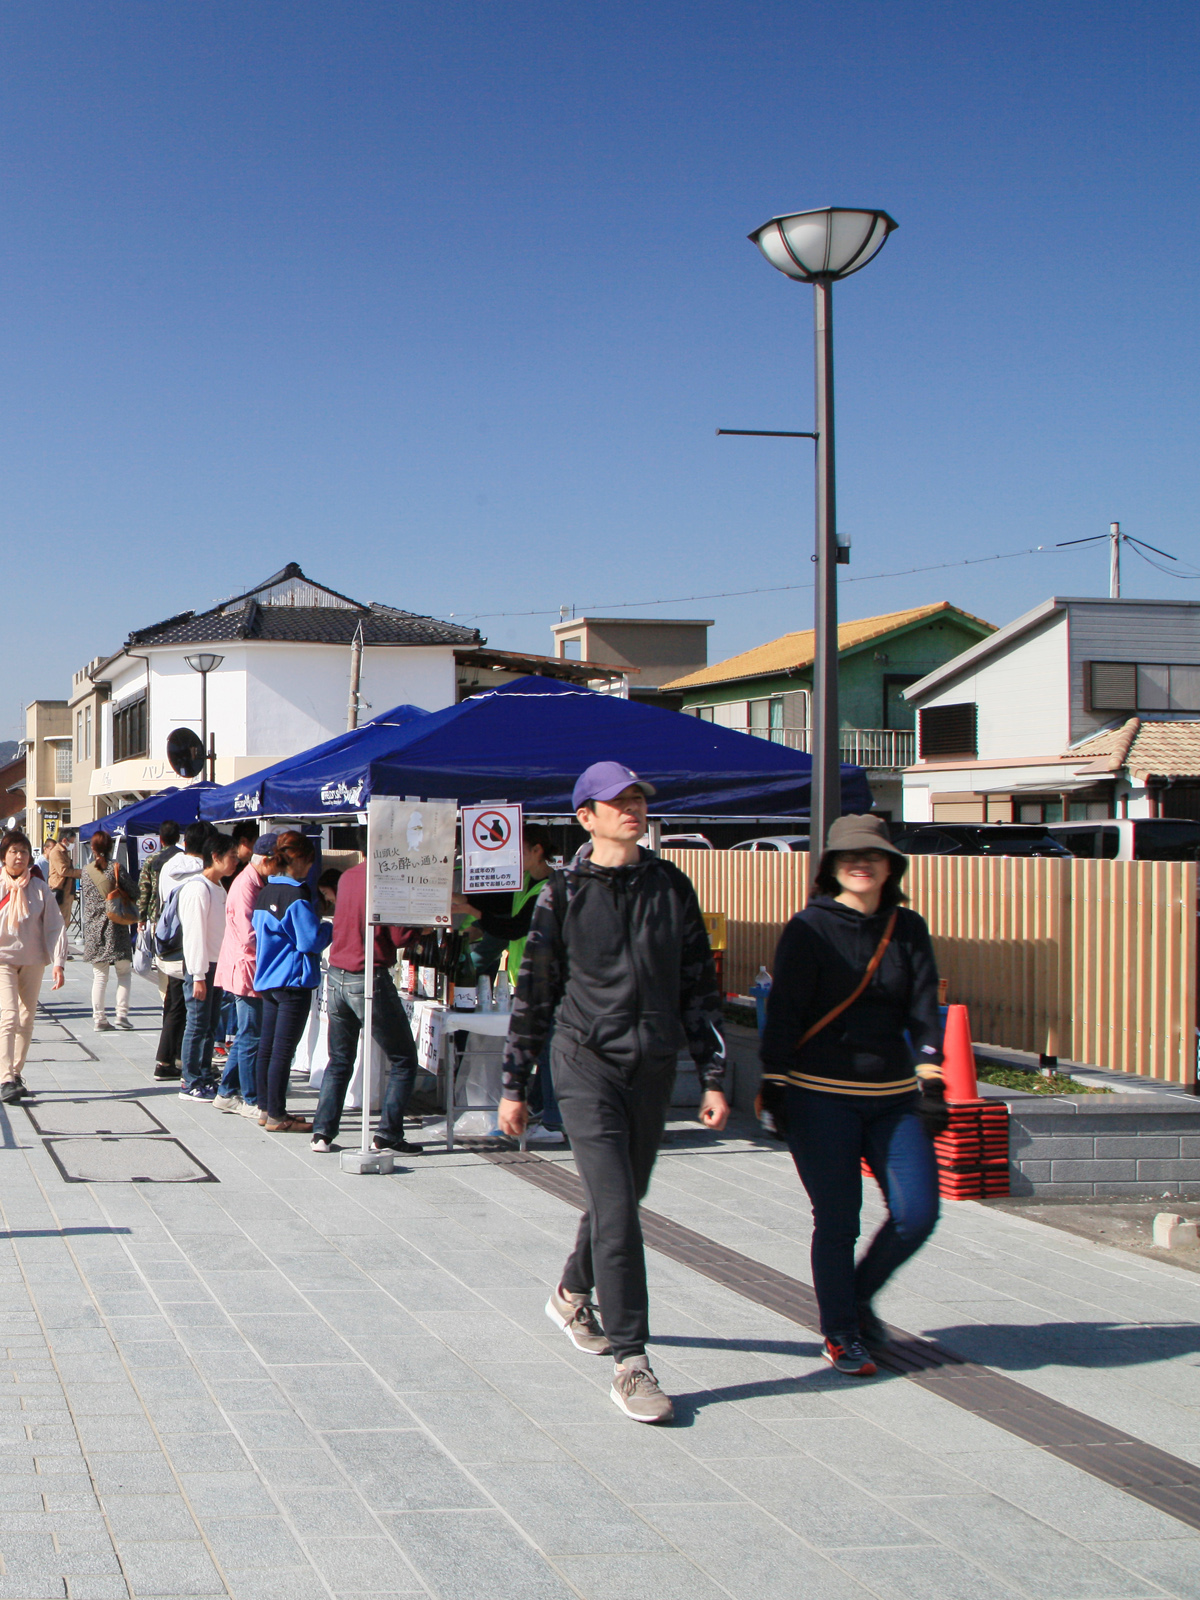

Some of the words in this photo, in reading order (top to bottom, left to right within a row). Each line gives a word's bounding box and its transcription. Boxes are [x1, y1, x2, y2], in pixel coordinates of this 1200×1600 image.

[373, 847, 400, 859] 山頭火
[378, 855, 438, 873] ほろ酔い通り
[407, 876, 429, 885] 11/16
[469, 880, 517, 888] 自転車でお越しの方
